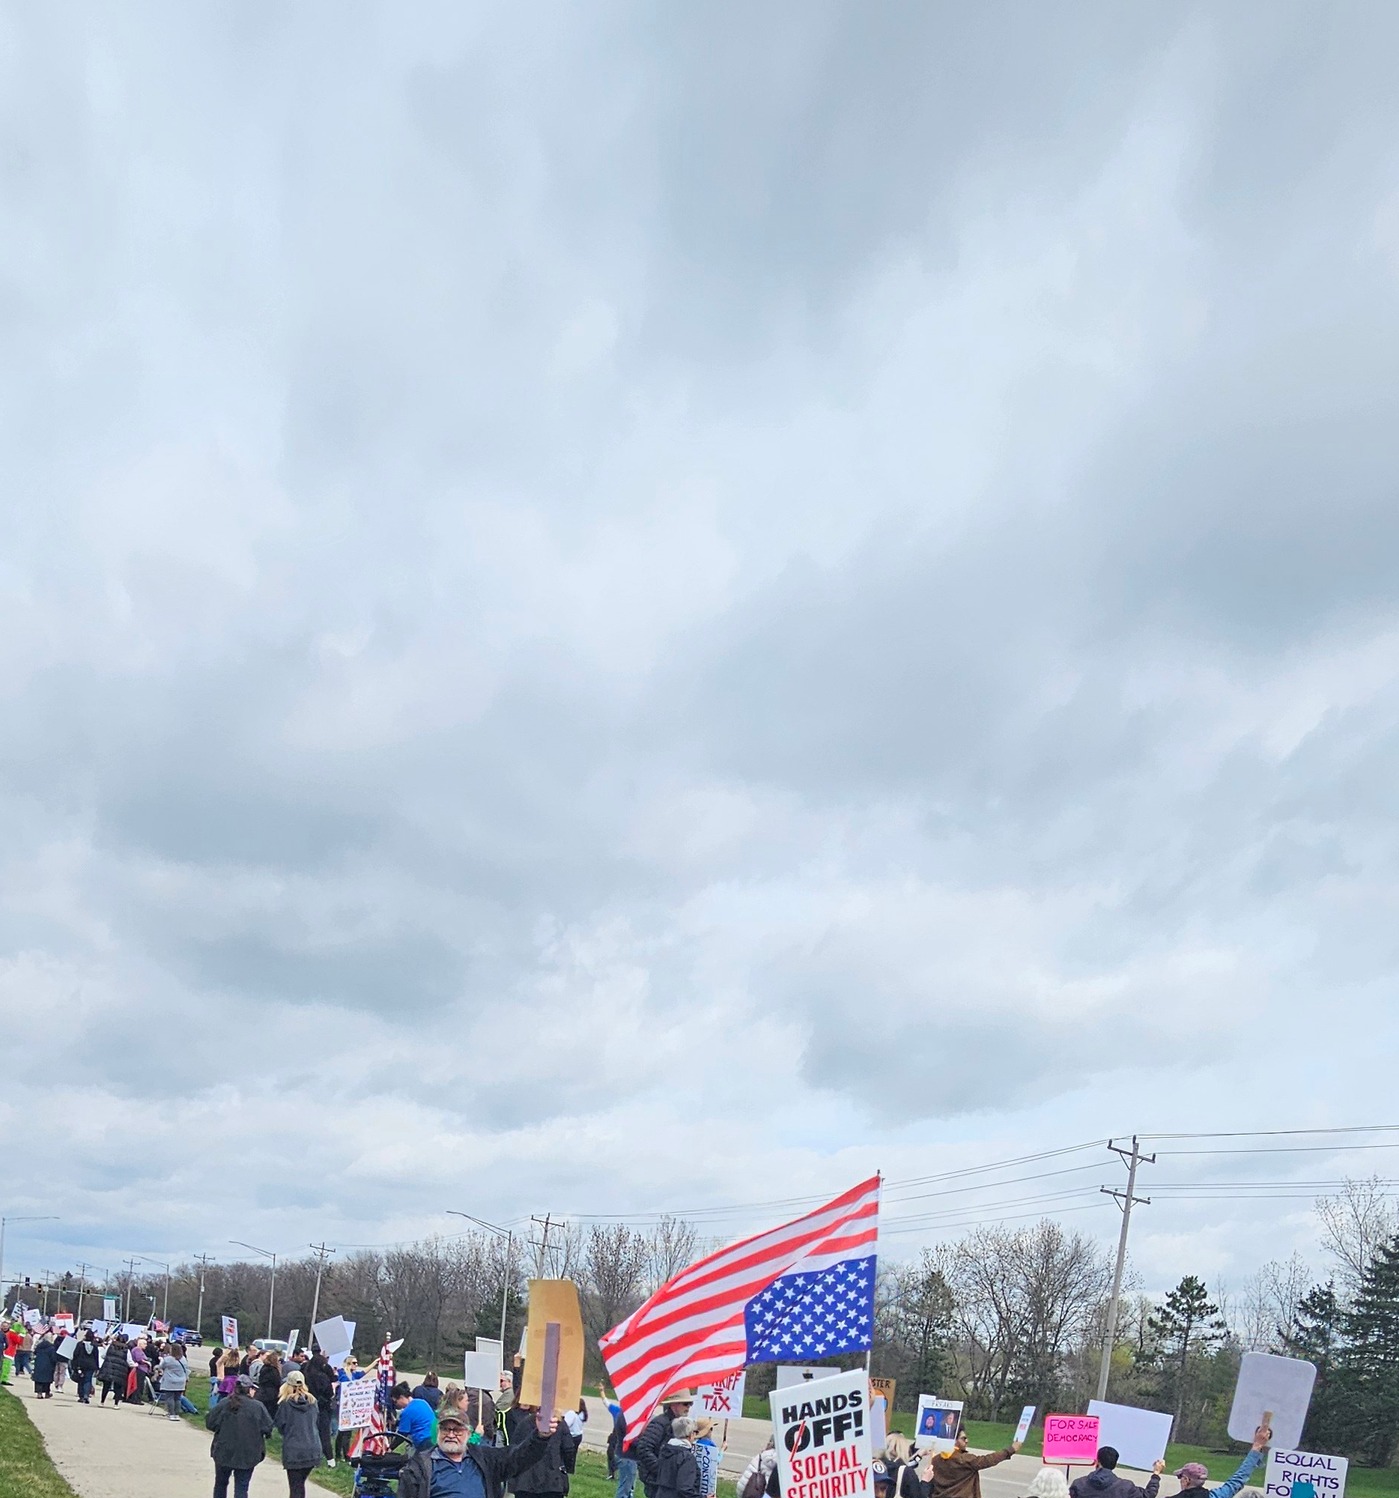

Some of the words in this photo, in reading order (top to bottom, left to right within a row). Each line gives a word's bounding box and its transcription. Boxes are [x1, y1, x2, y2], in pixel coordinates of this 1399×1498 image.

[871, 1378, 891, 1388] STER
[702, 1394, 731, 1412] TAX
[782, 1389, 863, 1424] HANDS
[784, 1409, 864, 1454] OFF!
[1050, 1419, 1076, 1430] FOR
[1077, 1420, 1099, 1429] SALE
[1047, 1433, 1098, 1443] DEMOCRACY
[791, 1445, 862, 1483] SOCIAL
[1275, 1451, 1337, 1471] EQUAL
[1282, 1470, 1339, 1490] RIGHTS
[1266, 1483, 1291, 1497] FO
